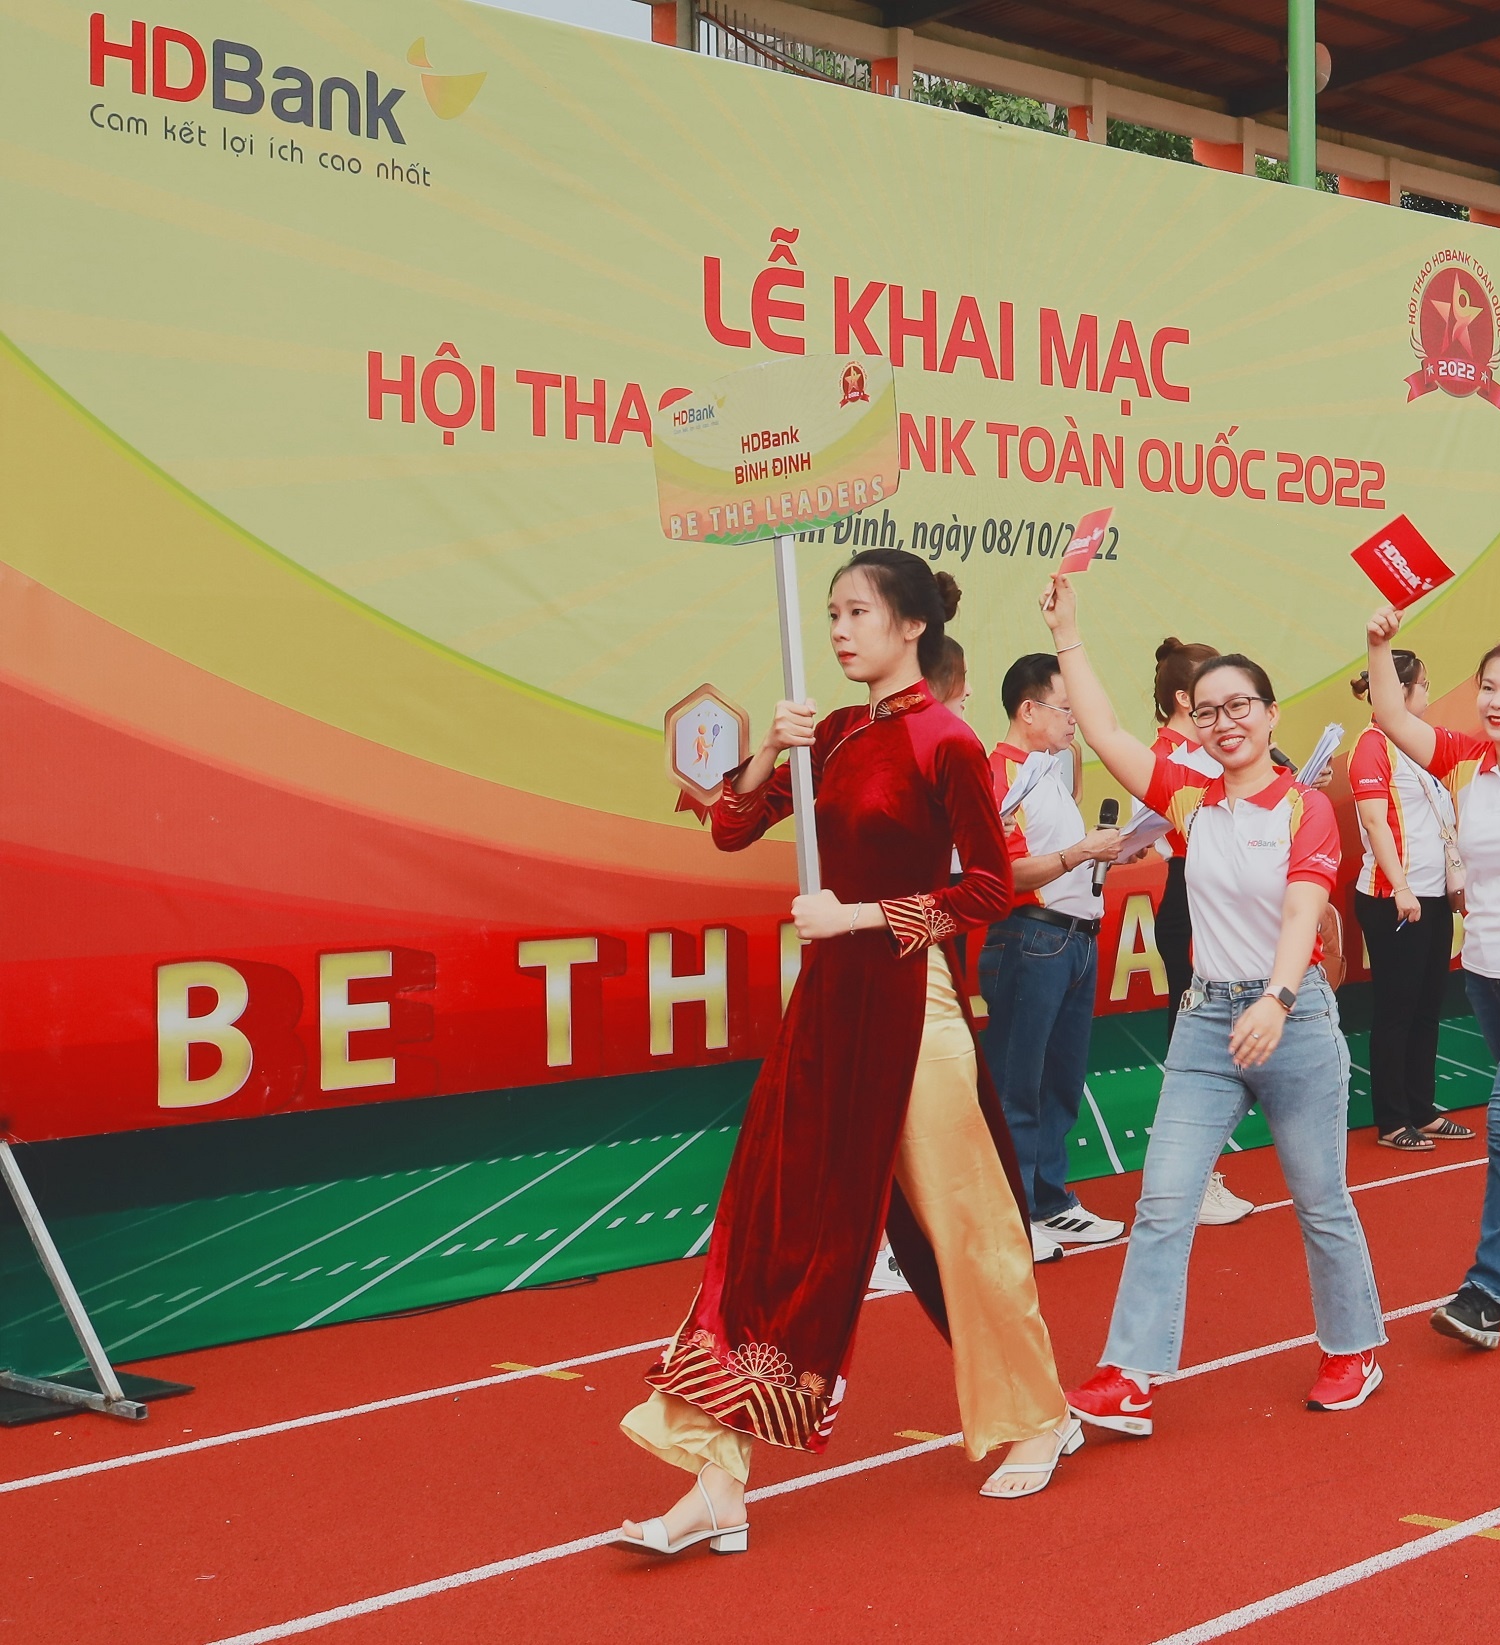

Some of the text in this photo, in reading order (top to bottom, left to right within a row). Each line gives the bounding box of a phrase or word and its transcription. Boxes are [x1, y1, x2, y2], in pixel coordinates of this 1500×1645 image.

[88, 12, 407, 145] HDBank
[90, 103, 432, 187] Cam kết lợi ích cao nhất
[1408, 297, 1419, 325] HỘI
[1432, 249, 1471, 267] HDBANK
[1473, 259, 1494, 295] TOÀN
[703, 227, 1192, 416] LỄ KHAI MẠC
[366, 341, 496, 446] HỘI
[1438, 360, 1476, 381] 2022
[673, 404, 716, 428] HDBank
[740, 426, 801, 454] HDBank
[734, 451, 812, 485] BÌNH ĐỊNH
[986, 414, 1124, 490] TOÀN
[1137, 425, 1267, 502] QUỐC
[1277, 451, 1387, 511] 2022
[669, 474, 885, 539] BE THE LEADERS
[911, 514, 977, 563] ngày
[982, 517, 1119, 561] 08/10/22
[1378, 539, 1423, 590] HDBank
[1247, 839, 1277, 848] HDBank
[156, 947, 397, 1110] BE
